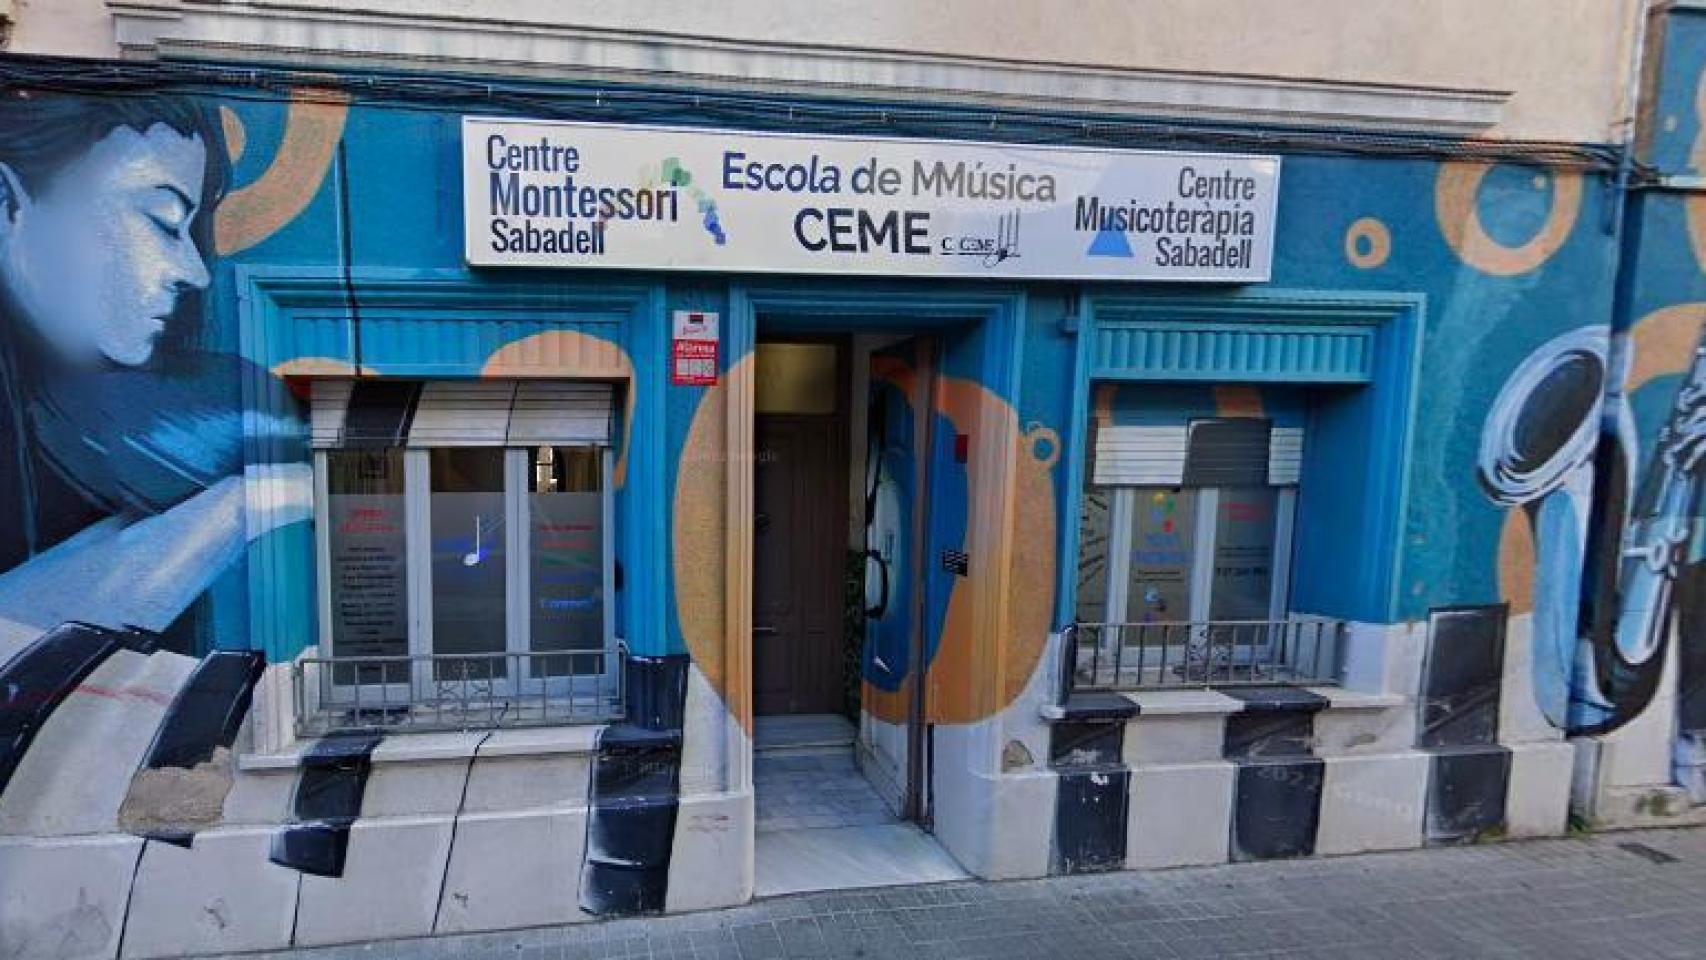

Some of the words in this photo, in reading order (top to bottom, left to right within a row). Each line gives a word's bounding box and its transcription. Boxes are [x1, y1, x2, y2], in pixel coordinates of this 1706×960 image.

[487, 134, 580, 172] Centre
[722, 151, 842, 194] Escola
[851, 157, 902, 196] de
[1177, 166, 1256, 200] Centre
[489, 173, 678, 222] Montessori
[1074, 196, 1255, 238] Musicoteràpia
[490, 218, 605, 256] Sabadell
[793, 207, 932, 255] CEME
[1155, 235, 1253, 270] Sabadell
